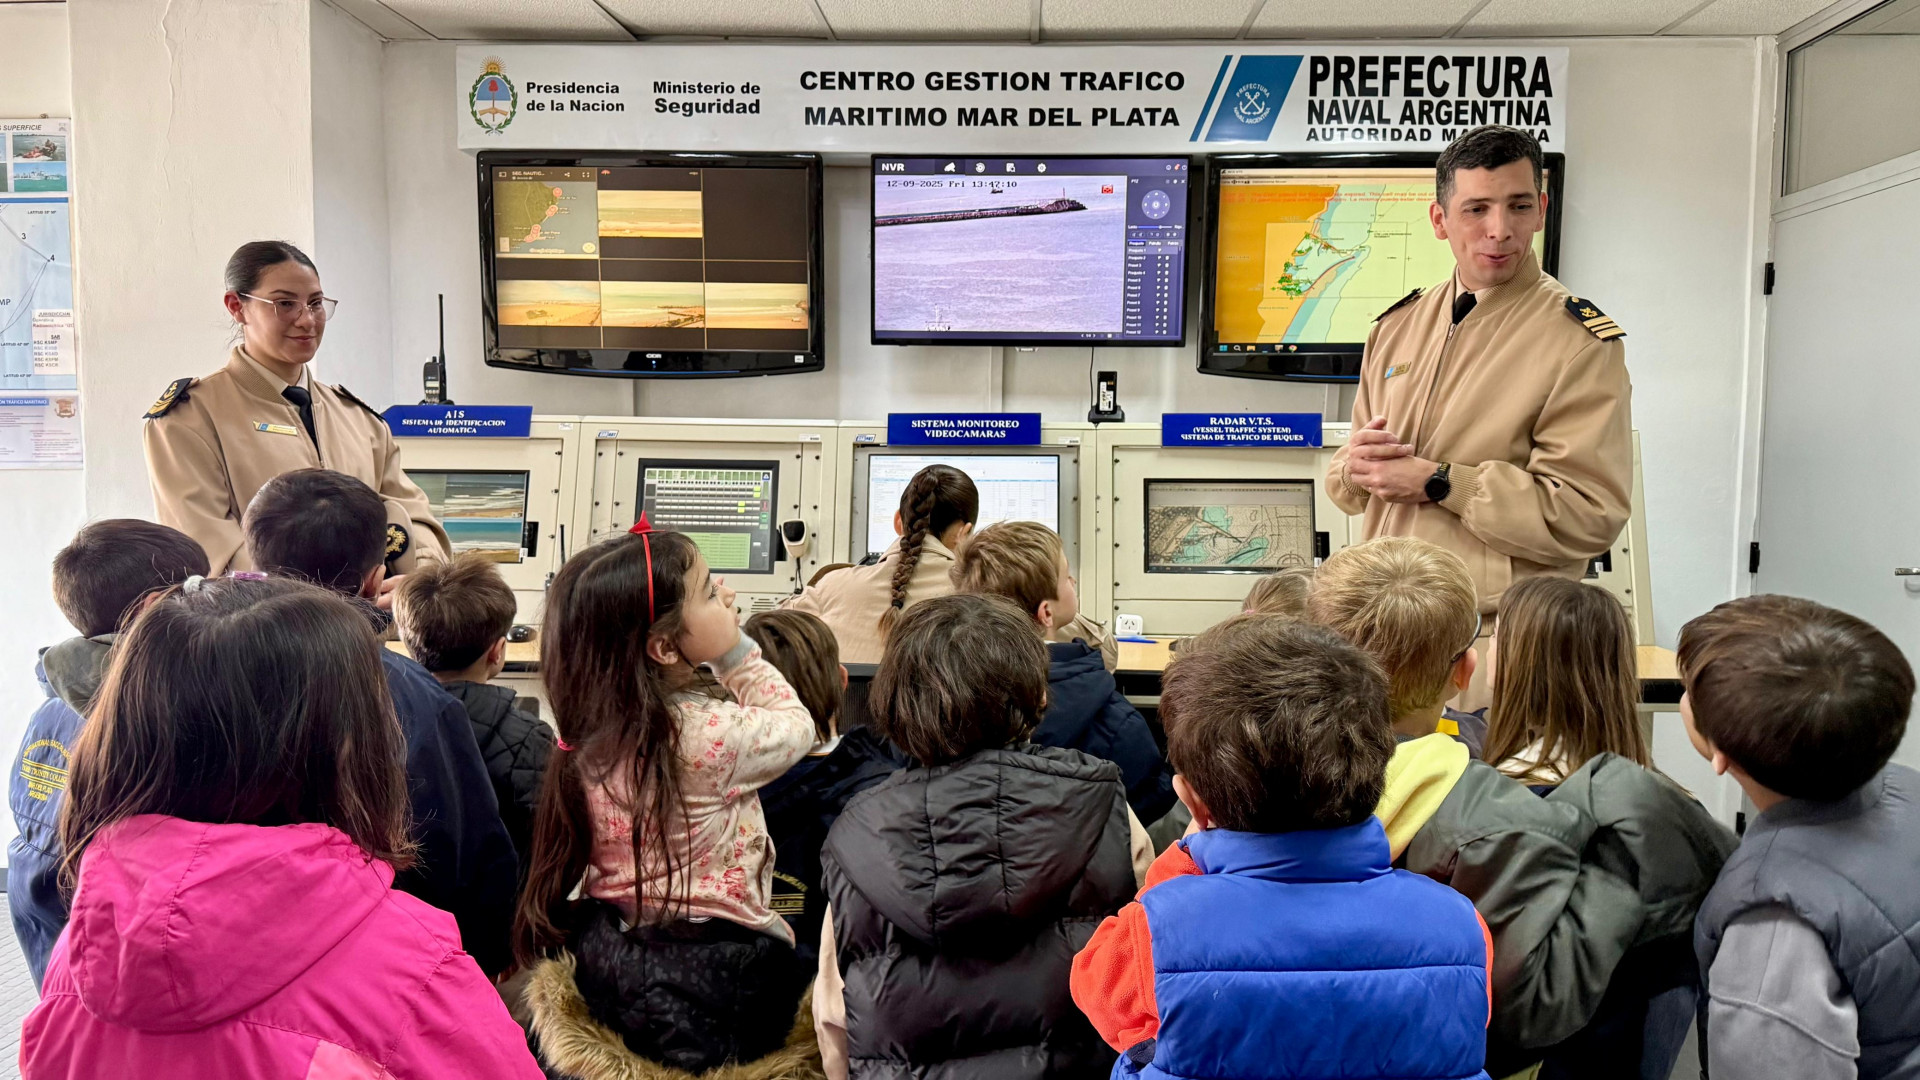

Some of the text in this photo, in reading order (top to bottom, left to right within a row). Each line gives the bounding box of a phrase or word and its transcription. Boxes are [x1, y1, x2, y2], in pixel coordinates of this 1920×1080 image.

[800, 71, 1185, 91] CENTRO GESTION TRAFICO
[1309, 55, 1553, 98] PREFECTURA
[526, 82, 620, 94] Presidencia
[653, 81, 761, 94] Ministerio de
[1236, 83, 1270, 98] PREFECTURA
[526, 100, 625, 112] de la Nacion
[655, 98, 761, 117] Seguridad
[804, 107, 1180, 127] MARITIMO MAR DEL PLATA
[1307, 99, 1552, 126] NAVAL ARGENTINA
[1306, 127, 1432, 142] AUTORIDAD
[881, 163, 905, 172] NVR
[887, 180, 943, 188] 12-09-2025
[949, 180, 965, 188] Fri
[21, 232, 27, 240] 3
[50, 254, 56, 262] 4
[445, 410, 465, 419] AIS
[911, 419, 1020, 428] SISTEMA MONITOREO
[1210, 417, 1274, 425] RADAR V.T.S.
[924, 429, 1006, 438] VIDEOCAMARAS
[1273, 434, 1304, 442] BUQUES
